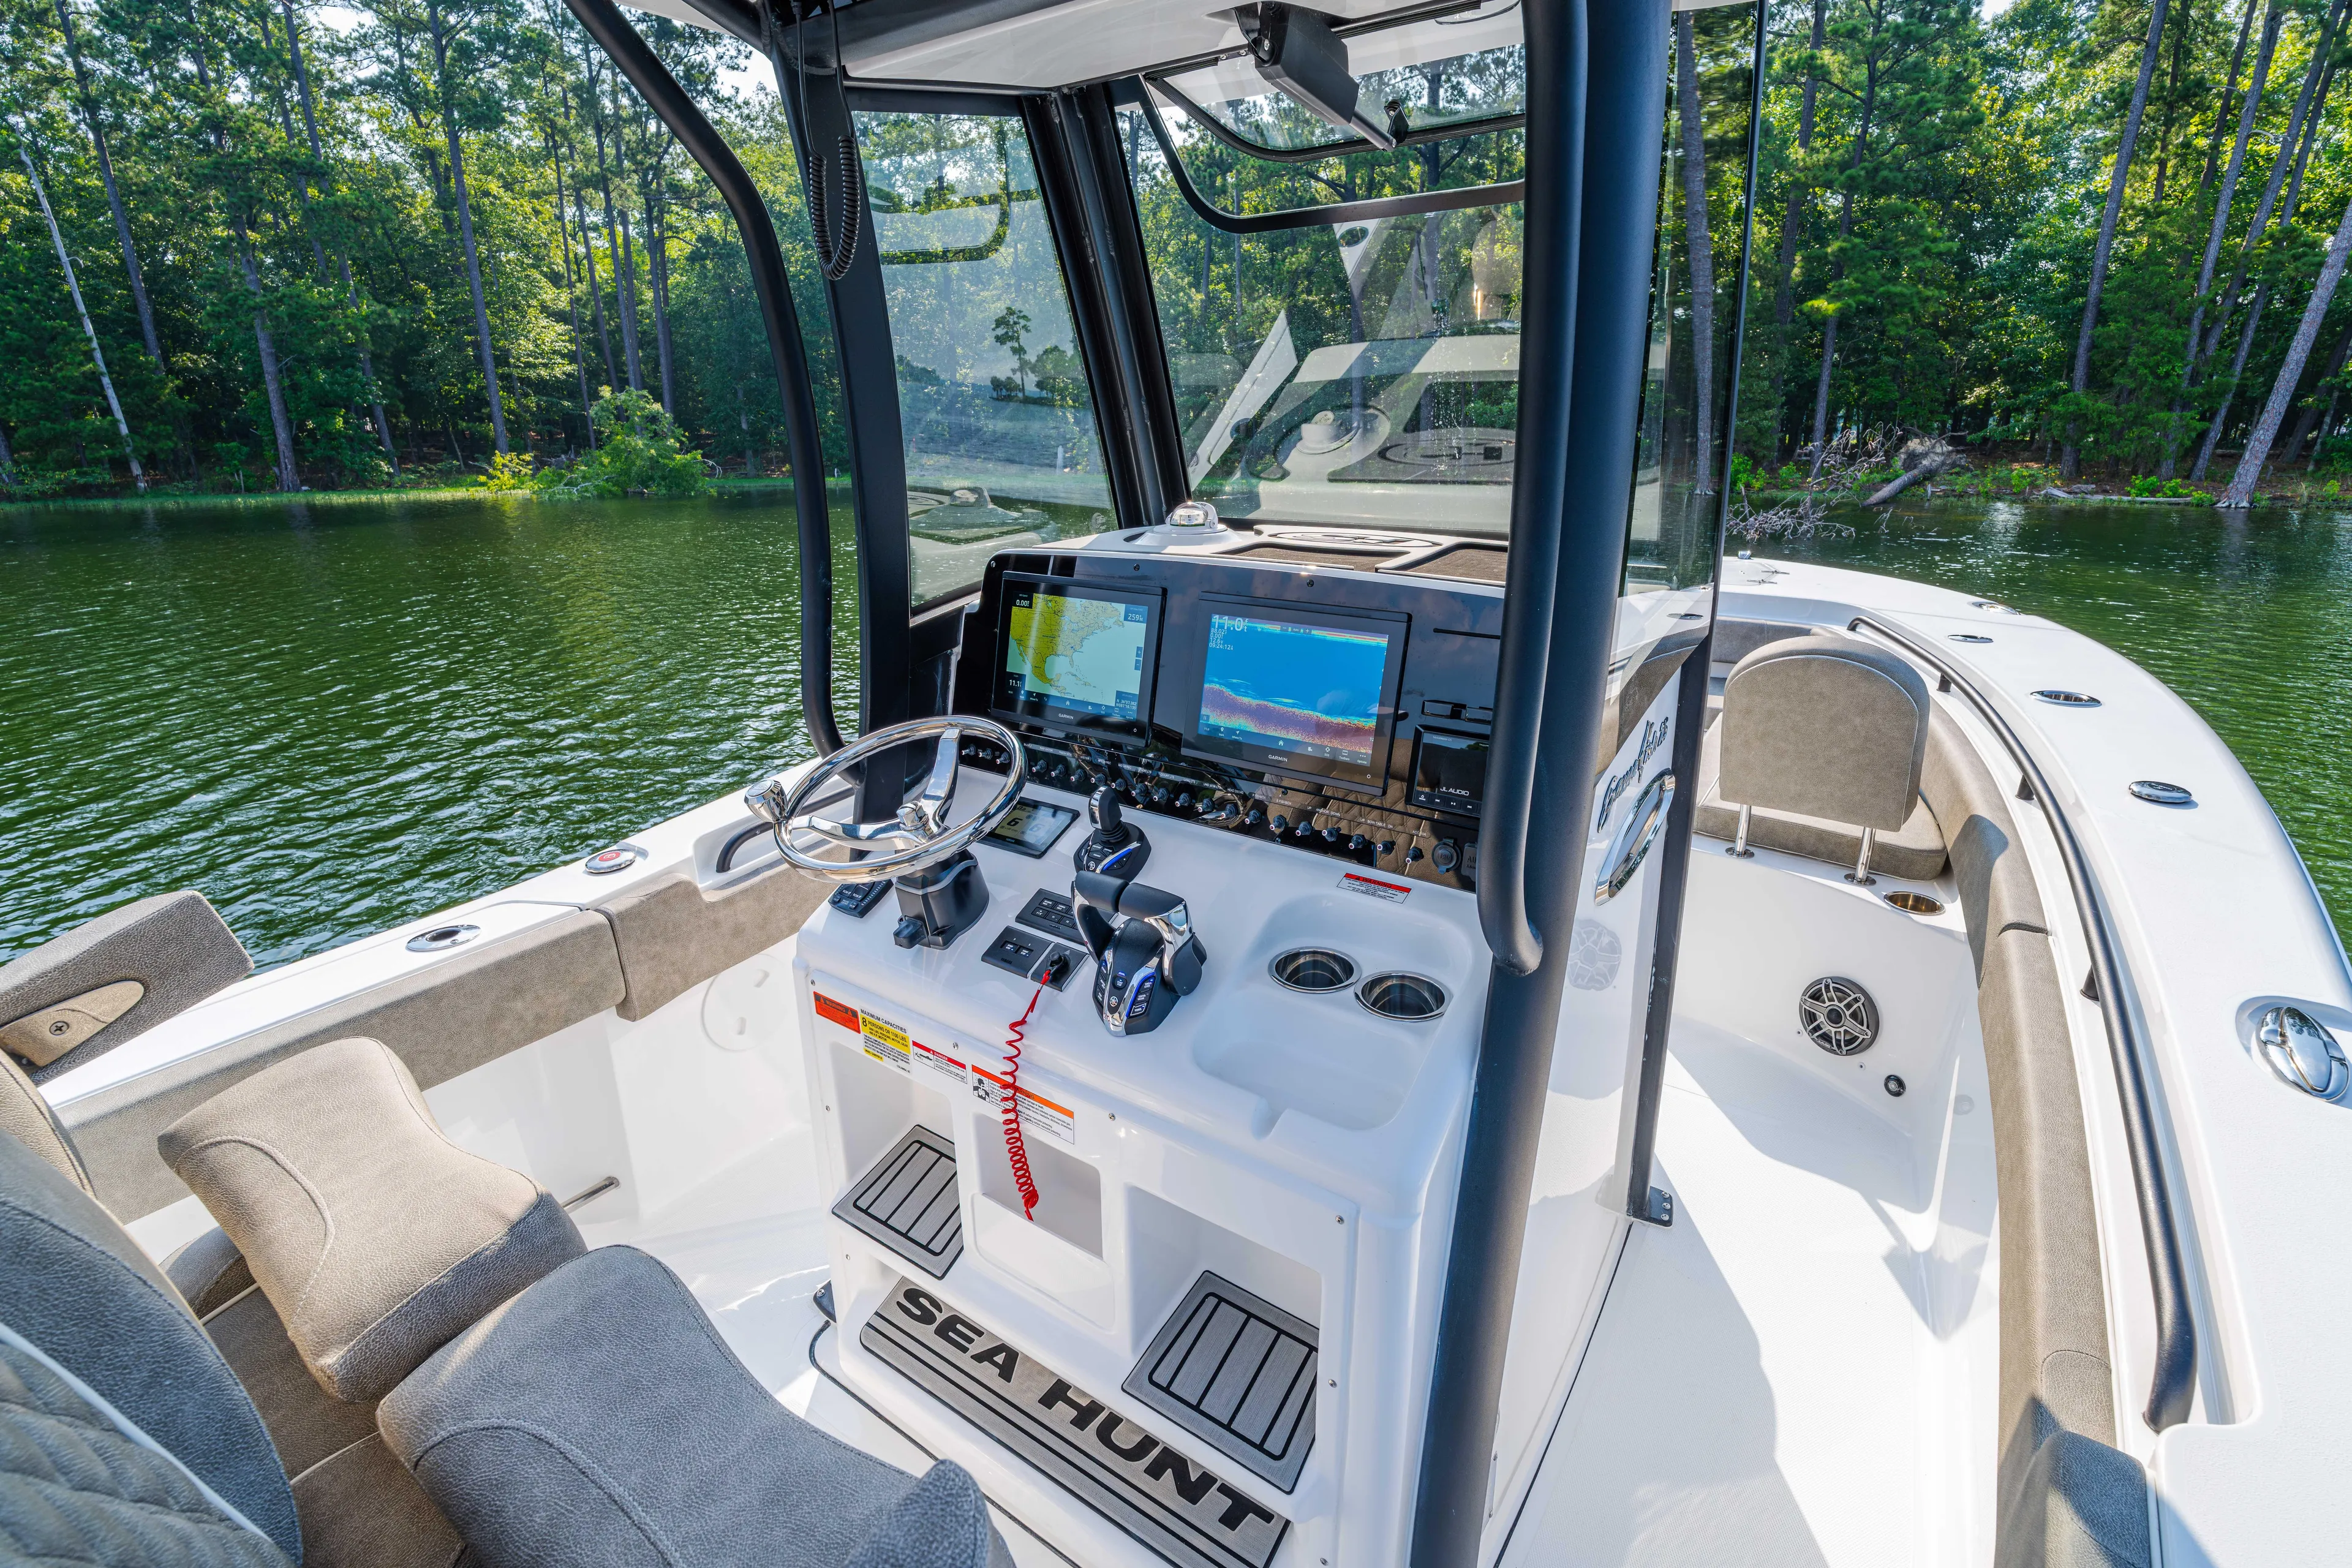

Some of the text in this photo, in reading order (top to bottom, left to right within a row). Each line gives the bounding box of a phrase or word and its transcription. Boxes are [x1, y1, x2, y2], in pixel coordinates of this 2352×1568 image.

[1213, 615, 1243, 631] 11.0
[1362, 878, 1392, 888] WARNING
[826, 1000, 846, 1012] WARNING
[861, 1008, 880, 1022] MAXIMUM
[881, 1018, 907, 1034] CAPACITIES
[862, 1016, 867, 1027] 8
[868, 1020, 884, 1032] PERSONS
[934, 1052, 948, 1061] DANGER
[895, 1287, 1275, 1531] SEA HUNT
